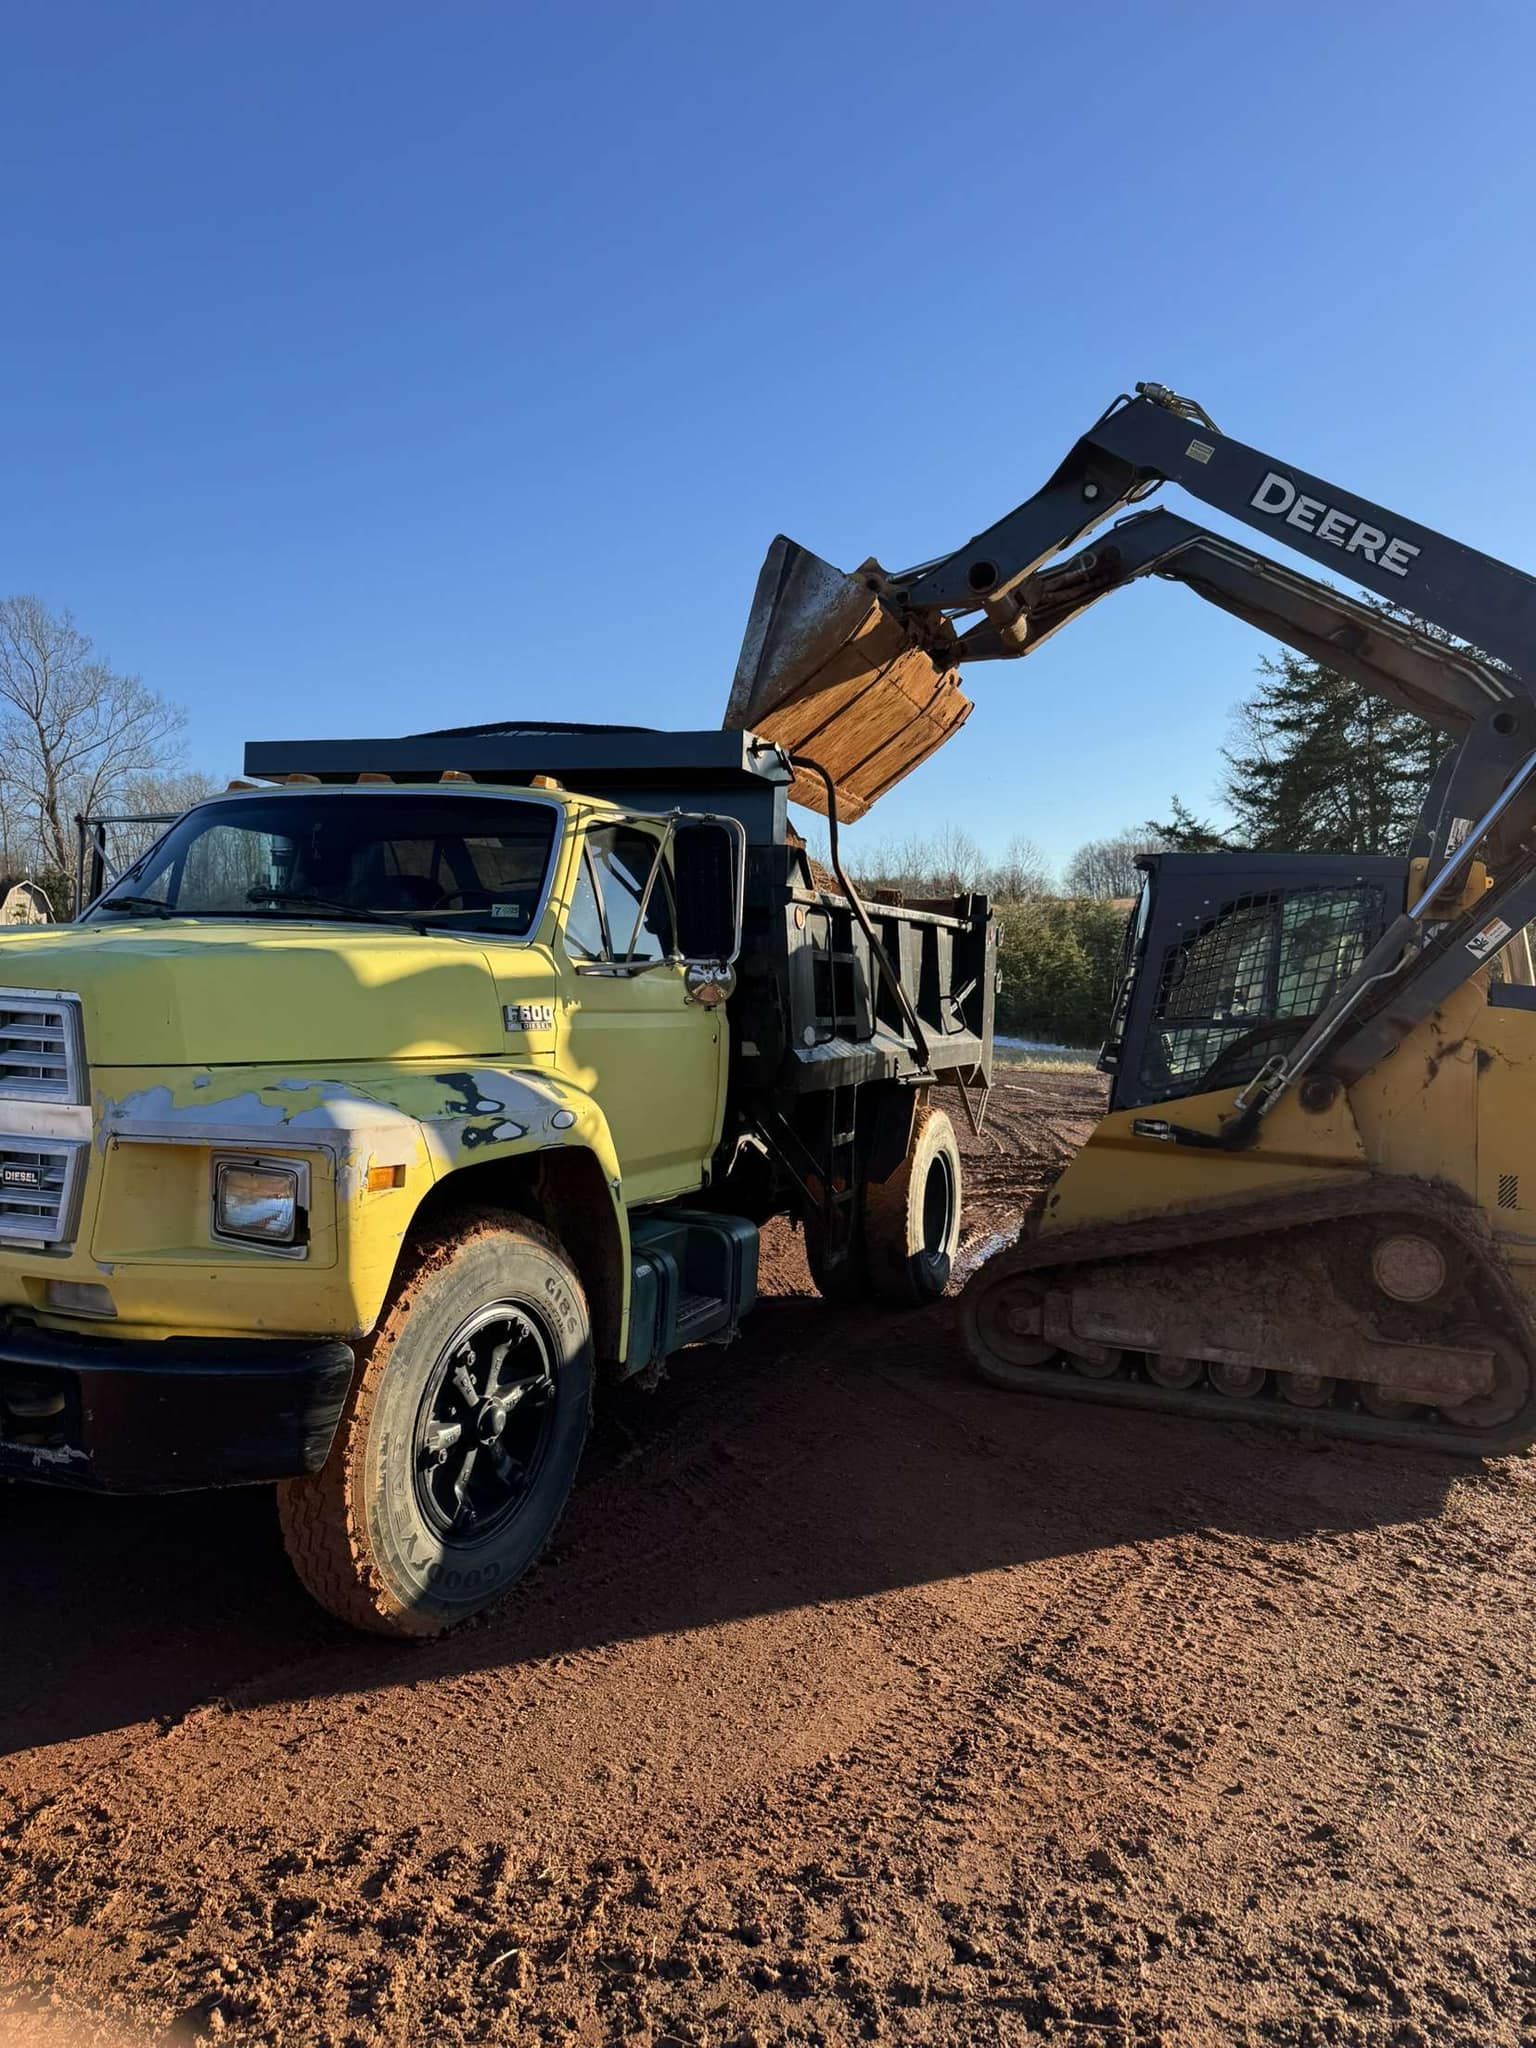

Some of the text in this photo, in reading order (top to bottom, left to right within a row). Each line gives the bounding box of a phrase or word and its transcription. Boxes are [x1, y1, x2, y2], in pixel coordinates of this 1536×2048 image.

[1250, 472, 1421, 577] DEERE
[507, 1005, 553, 1020] F600
[4, 1170, 38, 1183] DIESEL
[544, 1277, 578, 1334] G186
